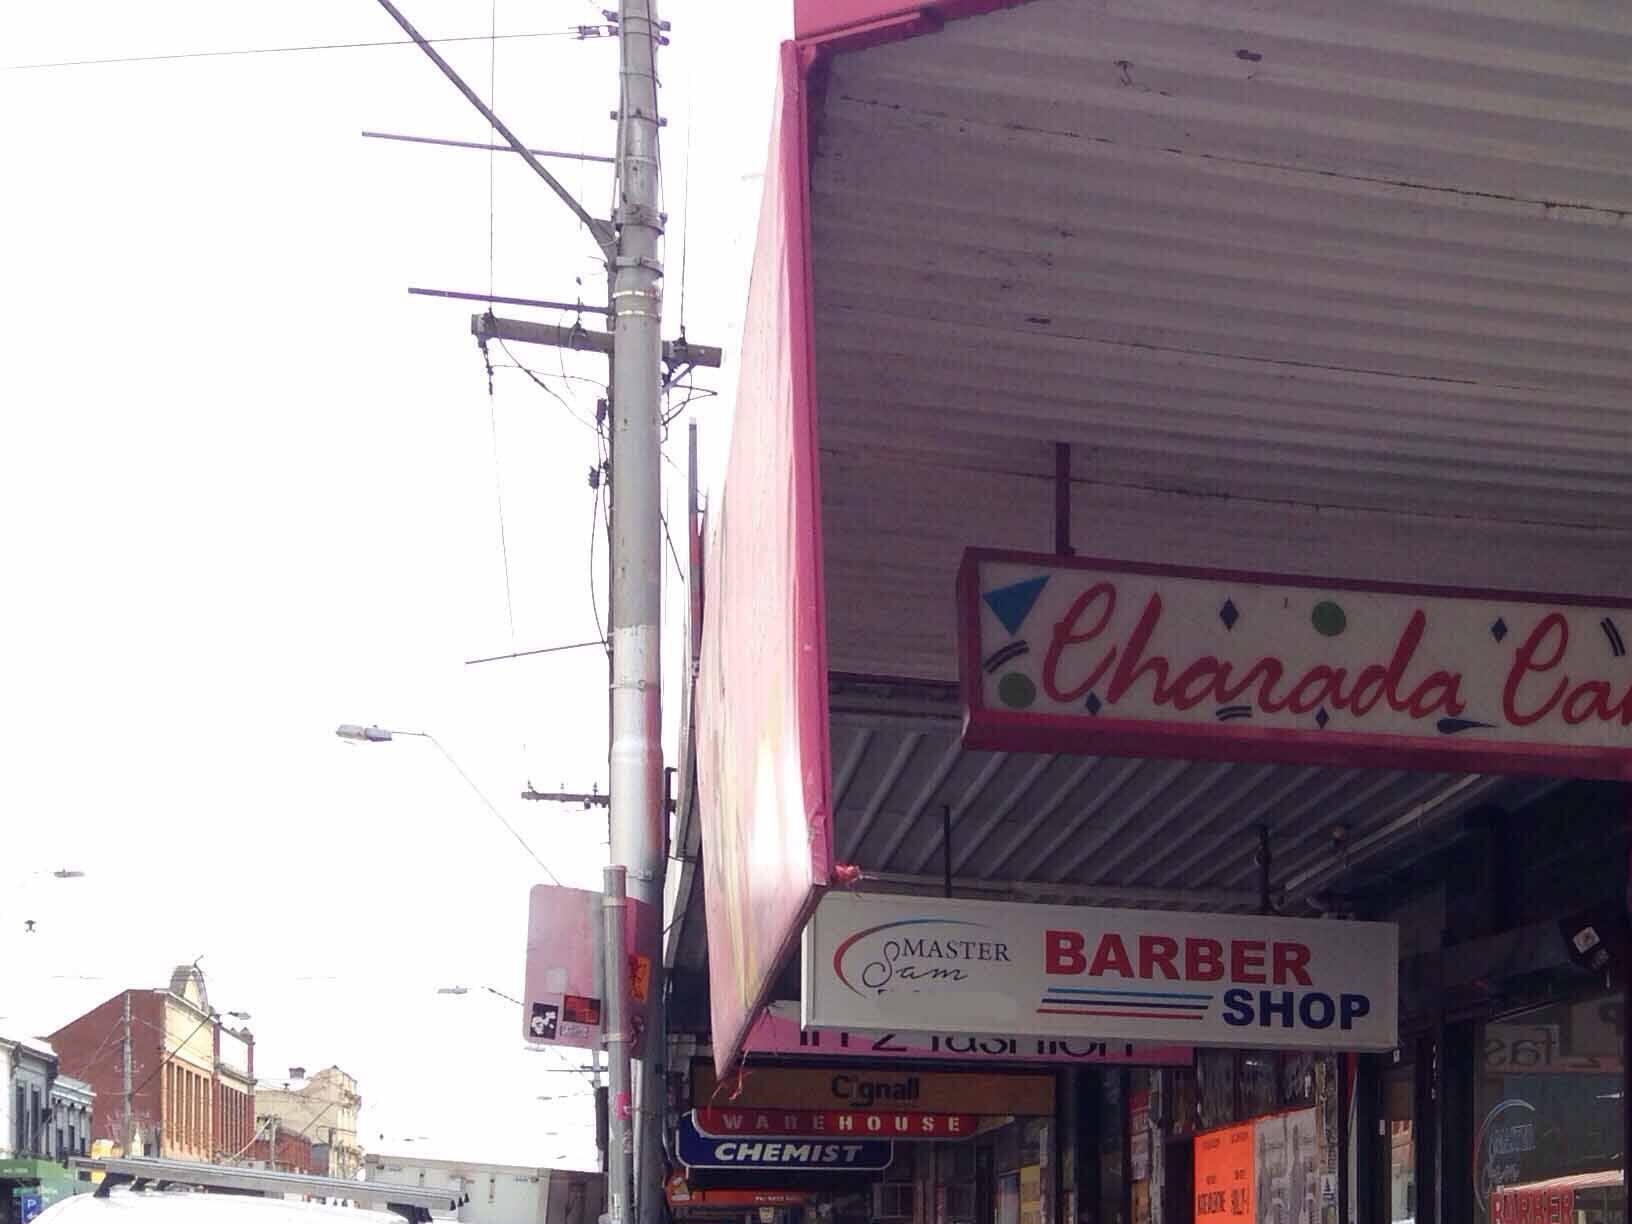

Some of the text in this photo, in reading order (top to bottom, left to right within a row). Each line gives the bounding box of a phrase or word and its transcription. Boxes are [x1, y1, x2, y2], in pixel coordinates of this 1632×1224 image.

[1042, 580, 1465, 717] Charada
[862, 940, 968, 988] Sam
[902, 937, 1011, 963] MASTER
[1043, 929, 1314, 986] BARBER
[1221, 987, 1371, 1031] SHOP
[722, 1113, 961, 1133] WAREHOUSE
[714, 1143, 863, 1163] CHEMIST
